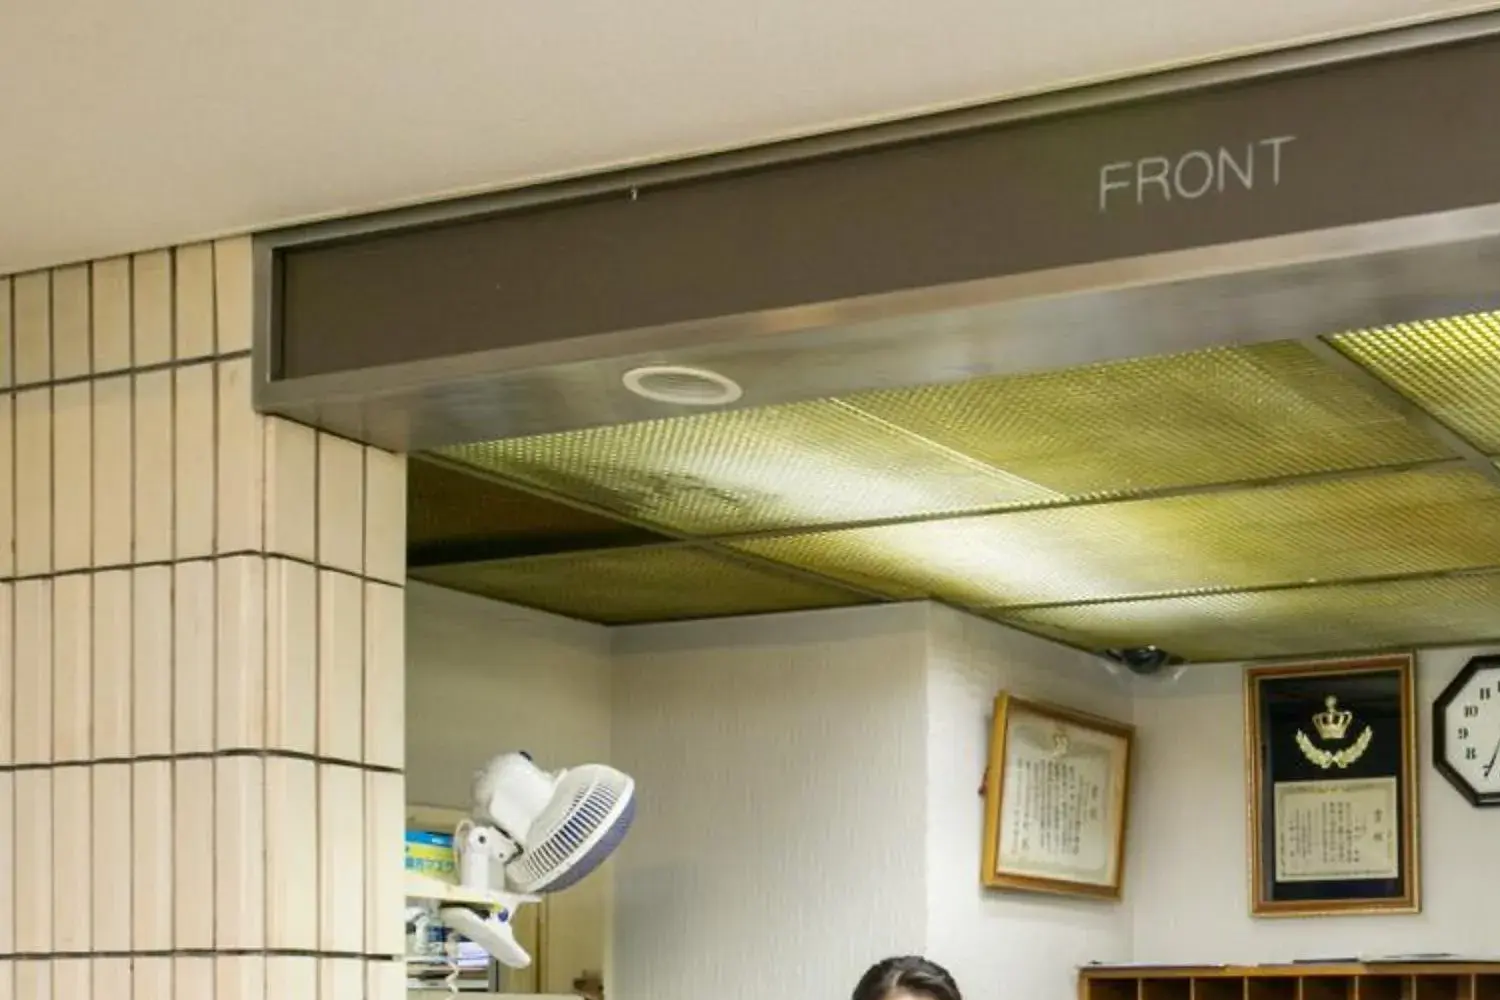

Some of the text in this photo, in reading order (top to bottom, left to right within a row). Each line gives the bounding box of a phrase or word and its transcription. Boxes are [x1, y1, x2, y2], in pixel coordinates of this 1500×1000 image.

[1100, 136, 1297, 212] FRONT
[1479, 687, 1491, 700] 11
[1463, 705, 1479, 717] 10
